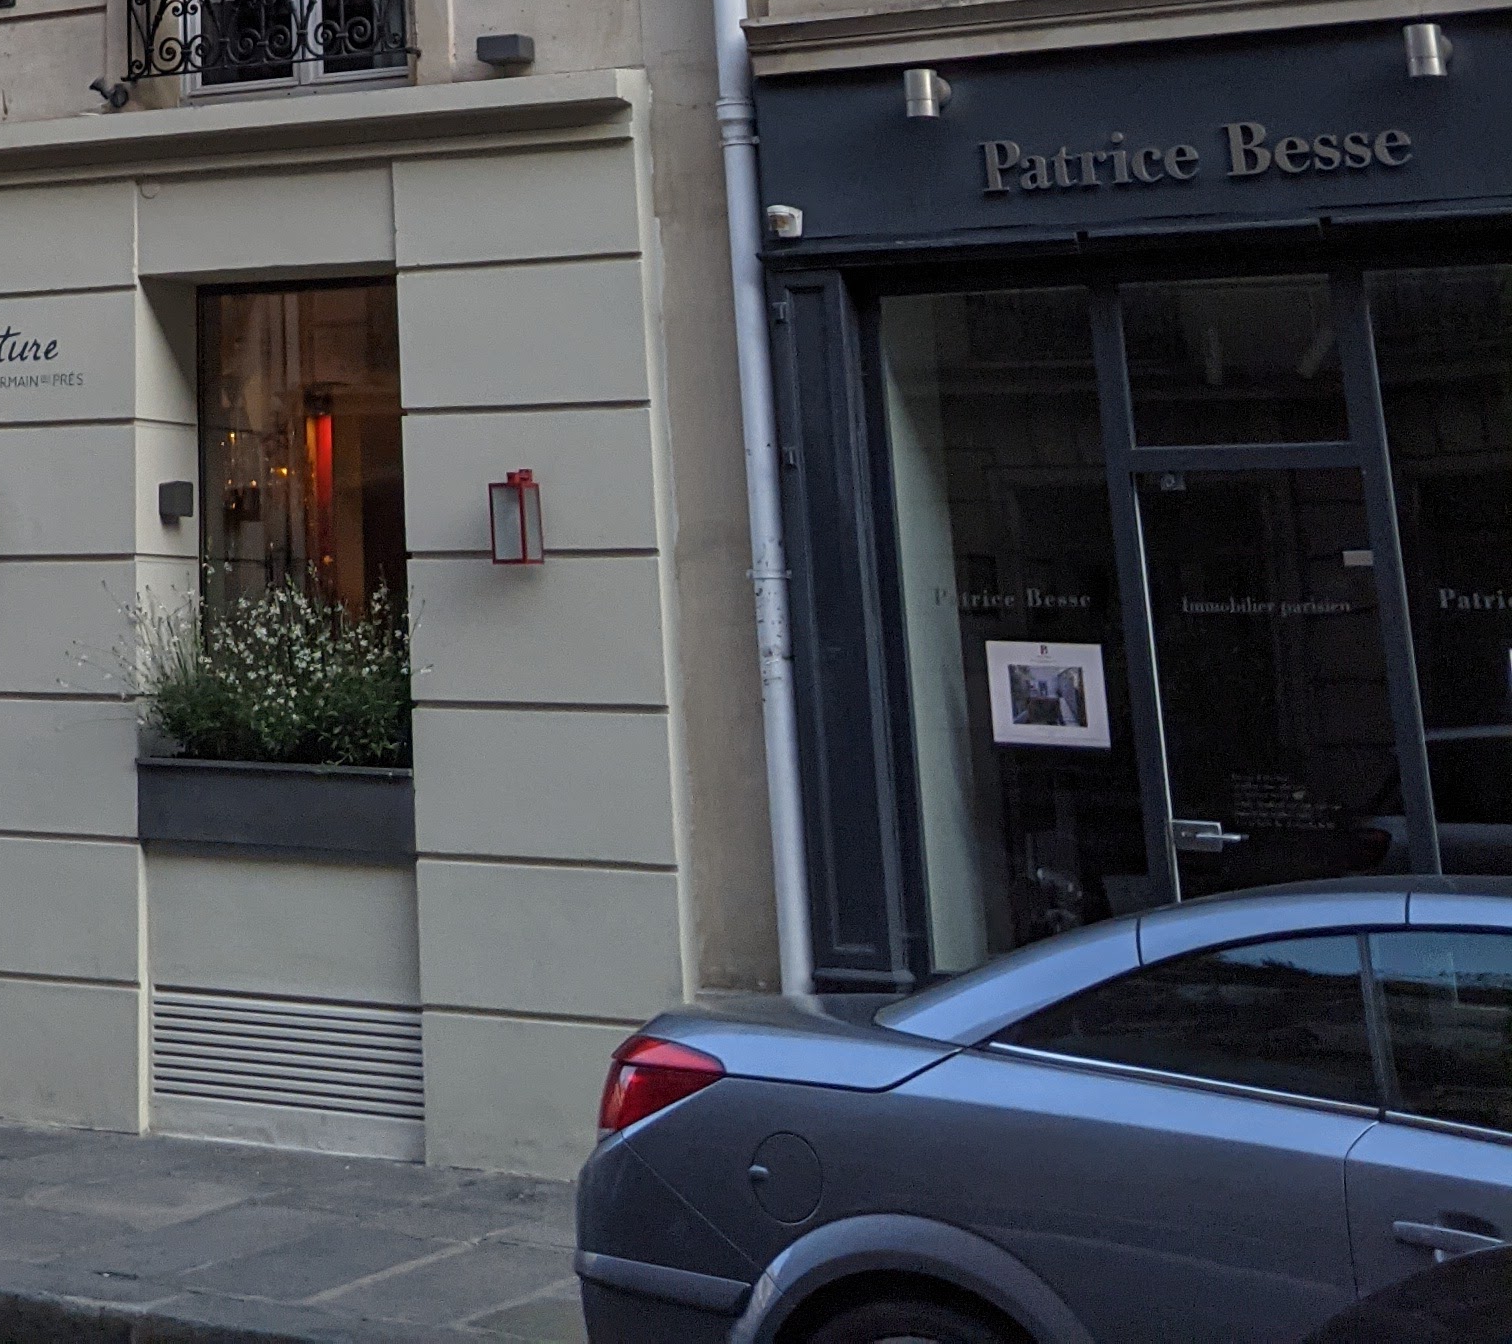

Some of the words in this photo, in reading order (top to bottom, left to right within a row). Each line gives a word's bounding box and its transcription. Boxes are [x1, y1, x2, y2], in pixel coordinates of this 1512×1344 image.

[979, 131, 1200, 192] Patrice
[1222, 121, 1413, 177] Besse
[933, 587, 1015, 608] Ptrice
[1025, 587, 1091, 608] Besse
